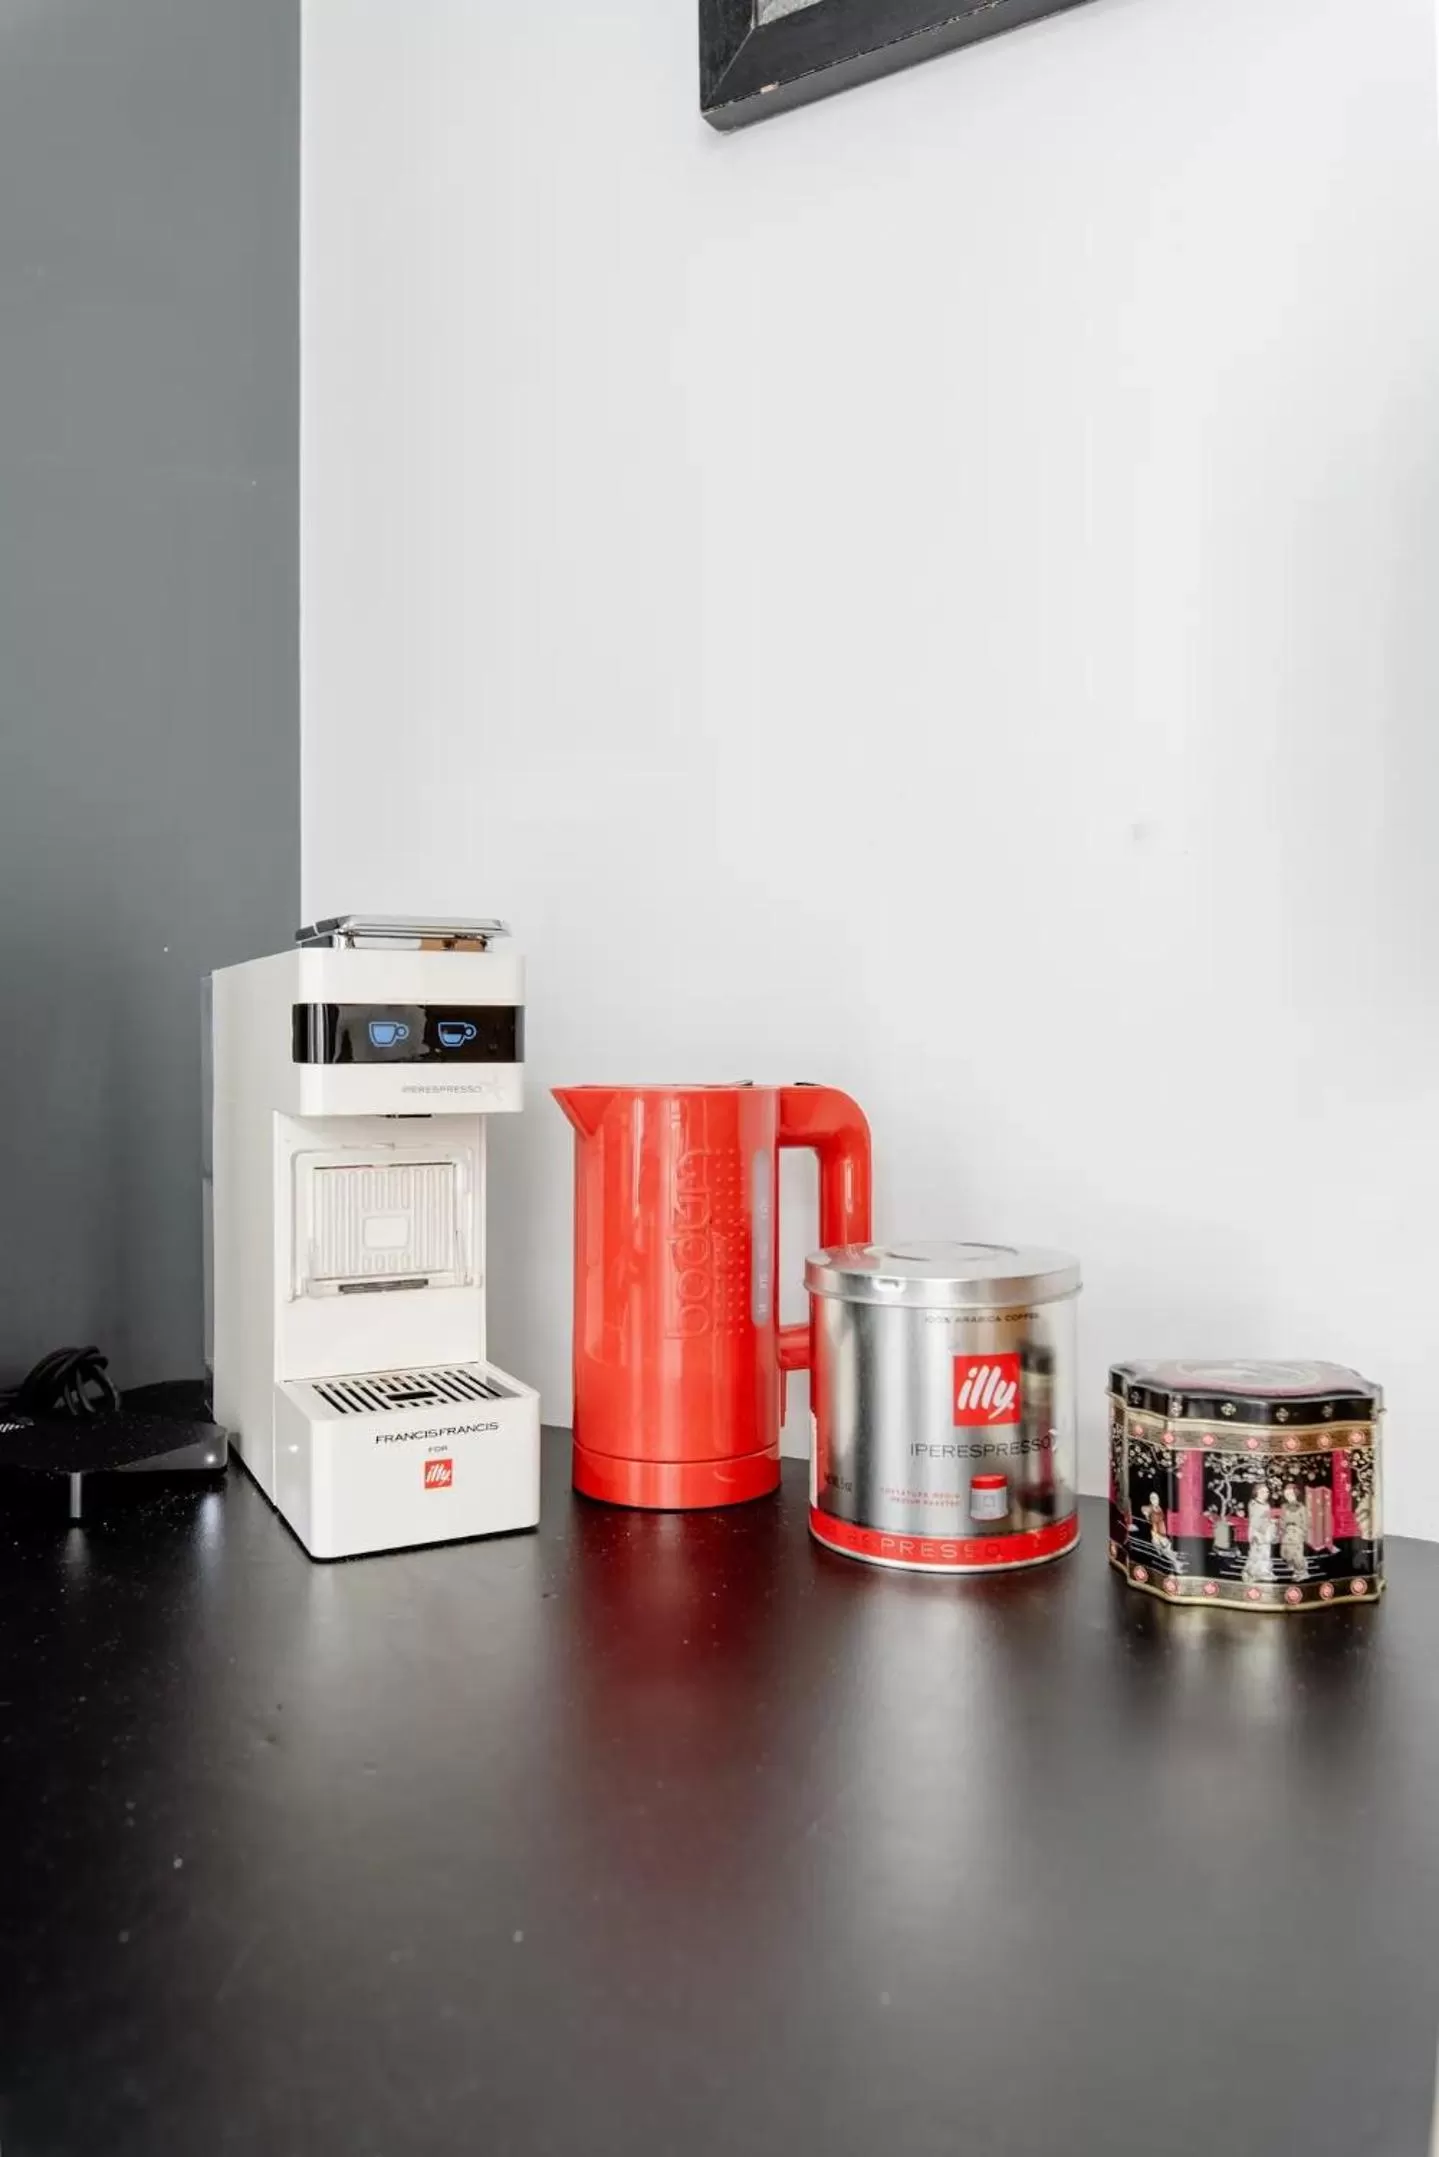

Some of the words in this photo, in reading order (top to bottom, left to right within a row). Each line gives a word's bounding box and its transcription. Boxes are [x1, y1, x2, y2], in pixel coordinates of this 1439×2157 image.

[957, 1364, 1017, 1420] illy
[428, 1445, 448, 1453] FOR
[910, 1435, 1051, 1459] IPERESPRESSO
[426, 1463, 451, 1486] illy
